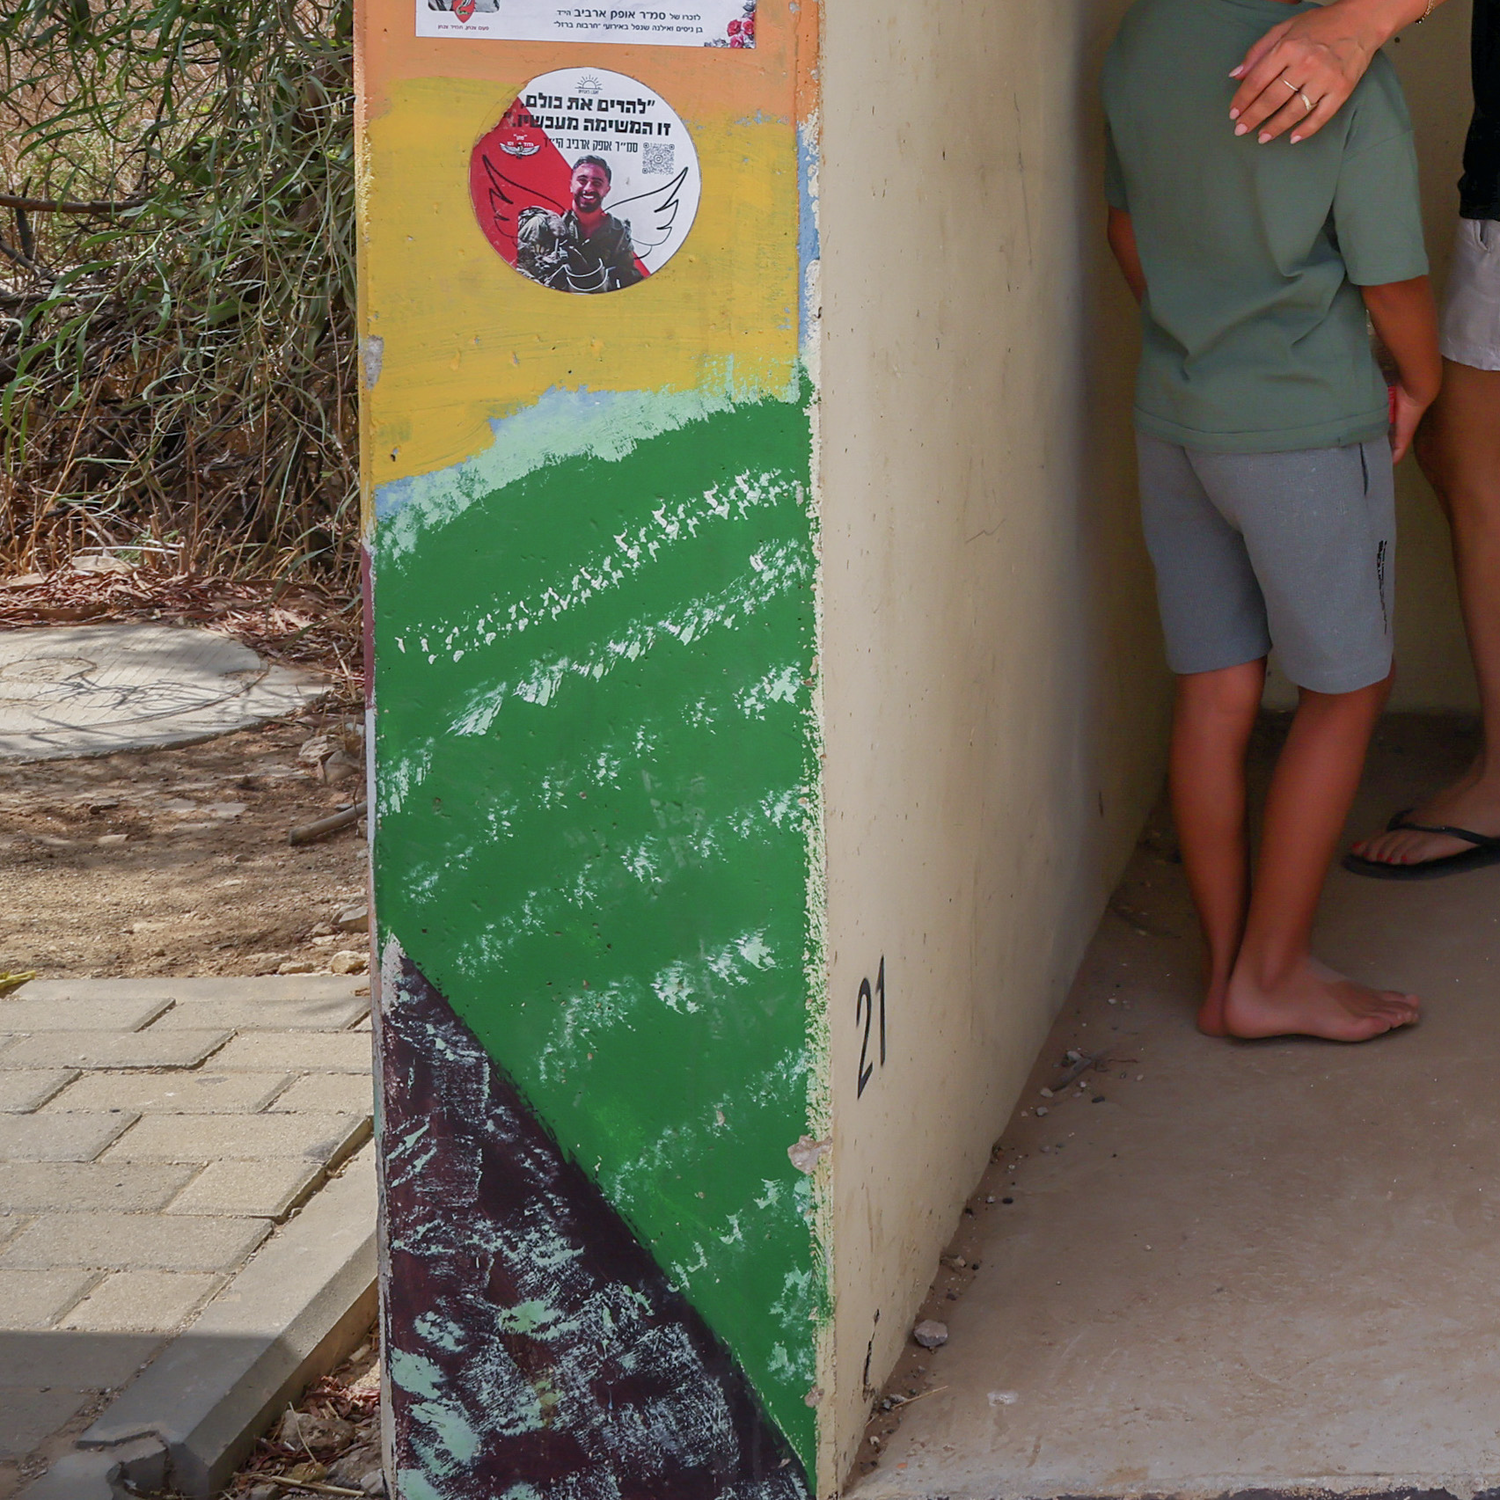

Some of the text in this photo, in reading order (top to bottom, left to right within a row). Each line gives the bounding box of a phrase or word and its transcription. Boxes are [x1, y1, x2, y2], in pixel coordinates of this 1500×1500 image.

[521, 94, 655, 114] "להרים את כולם,
[584, 119, 653, 135] המשימה
[658, 123, 671, 136] זו
[856, 954, 886, 1100] 21
